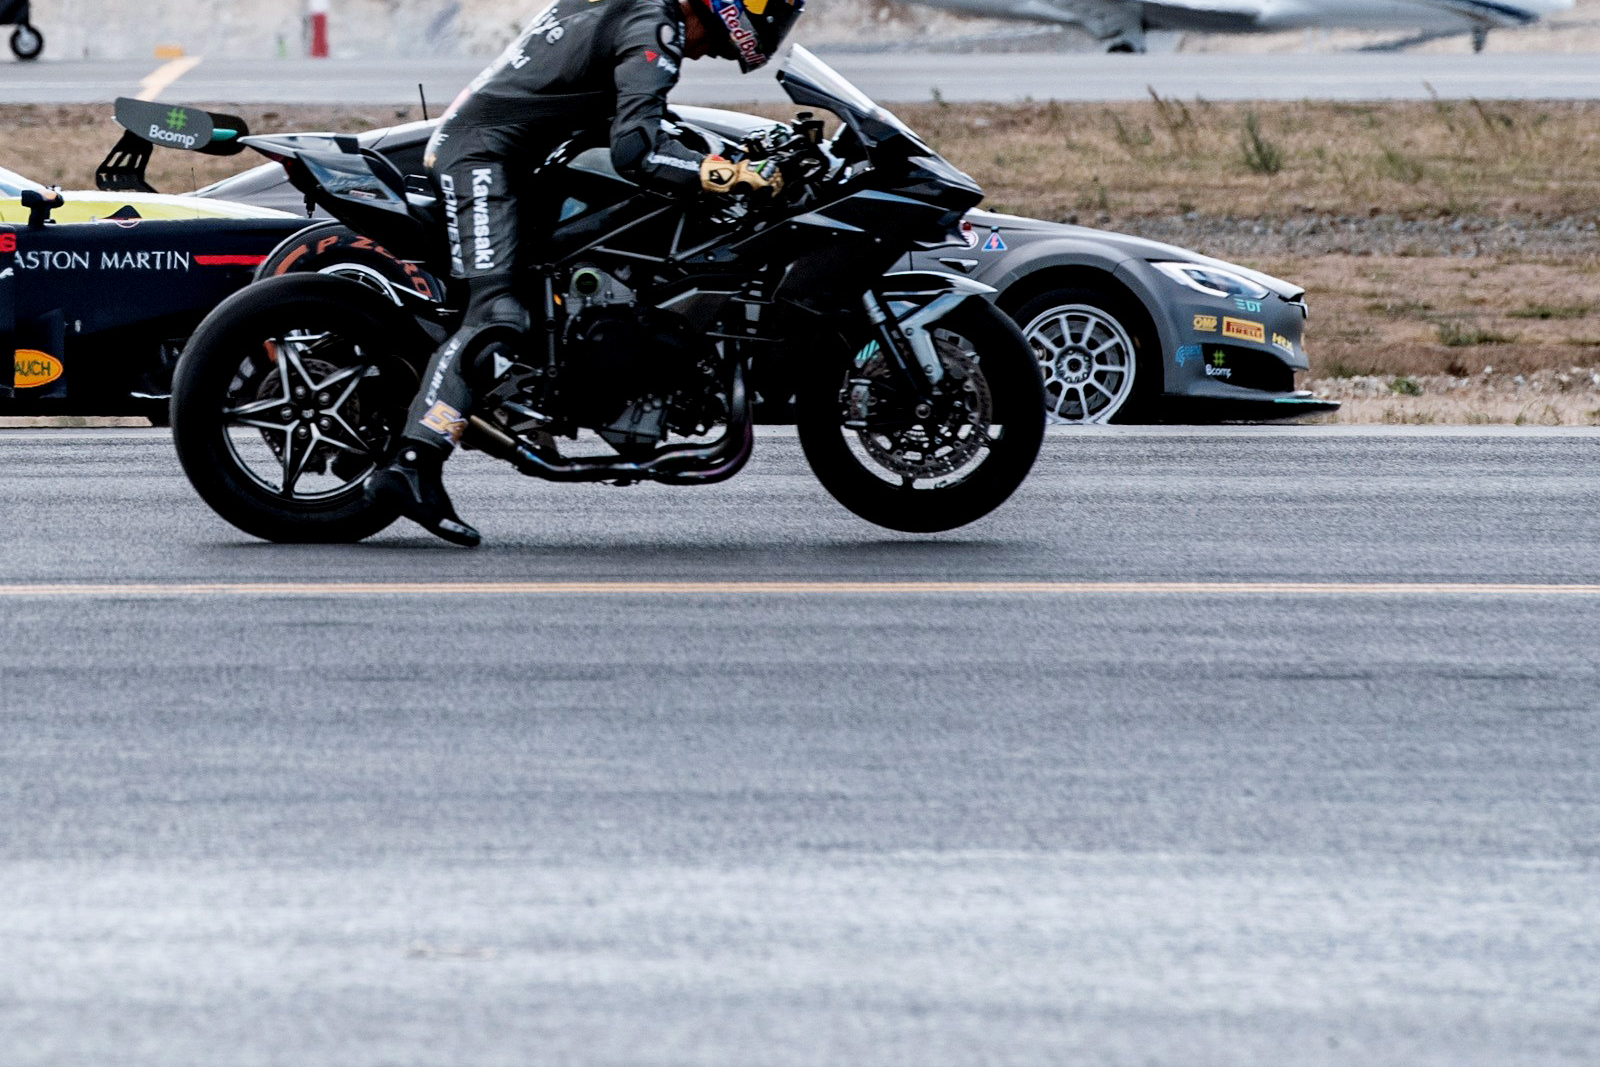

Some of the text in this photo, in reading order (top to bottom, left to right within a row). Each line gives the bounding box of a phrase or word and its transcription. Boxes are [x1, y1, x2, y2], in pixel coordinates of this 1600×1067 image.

[149, 124, 196, 148] Bcomp
[472, 168, 495, 269] Kawasaki
[14, 250, 190, 271] ASTON MARTIN
[1225, 321, 1263, 339] PIRELLI
[15, 360, 51, 376] AUCH
